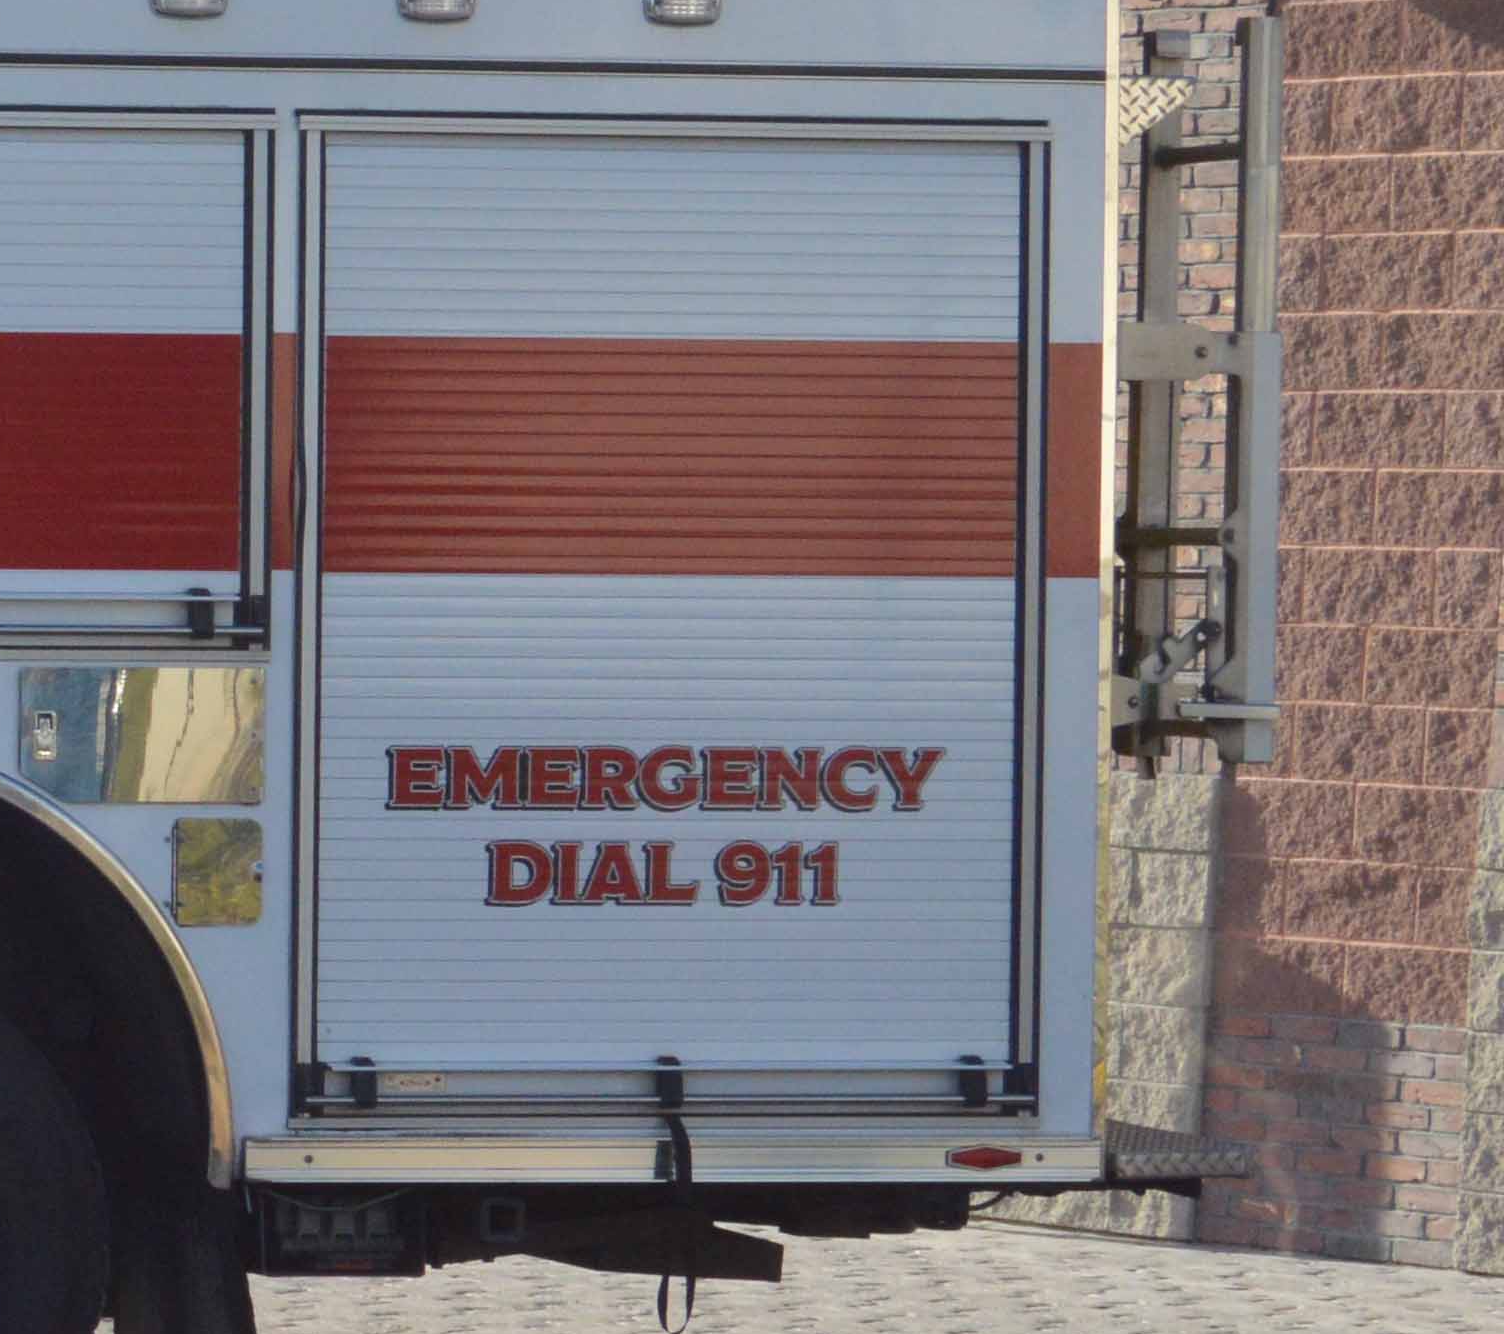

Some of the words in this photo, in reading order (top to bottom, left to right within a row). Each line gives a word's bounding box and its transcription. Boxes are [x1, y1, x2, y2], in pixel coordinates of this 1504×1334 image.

[385, 744, 946, 811] EMERGENCY
[484, 840, 701, 906] DIAL
[716, 840, 841, 906] 911
